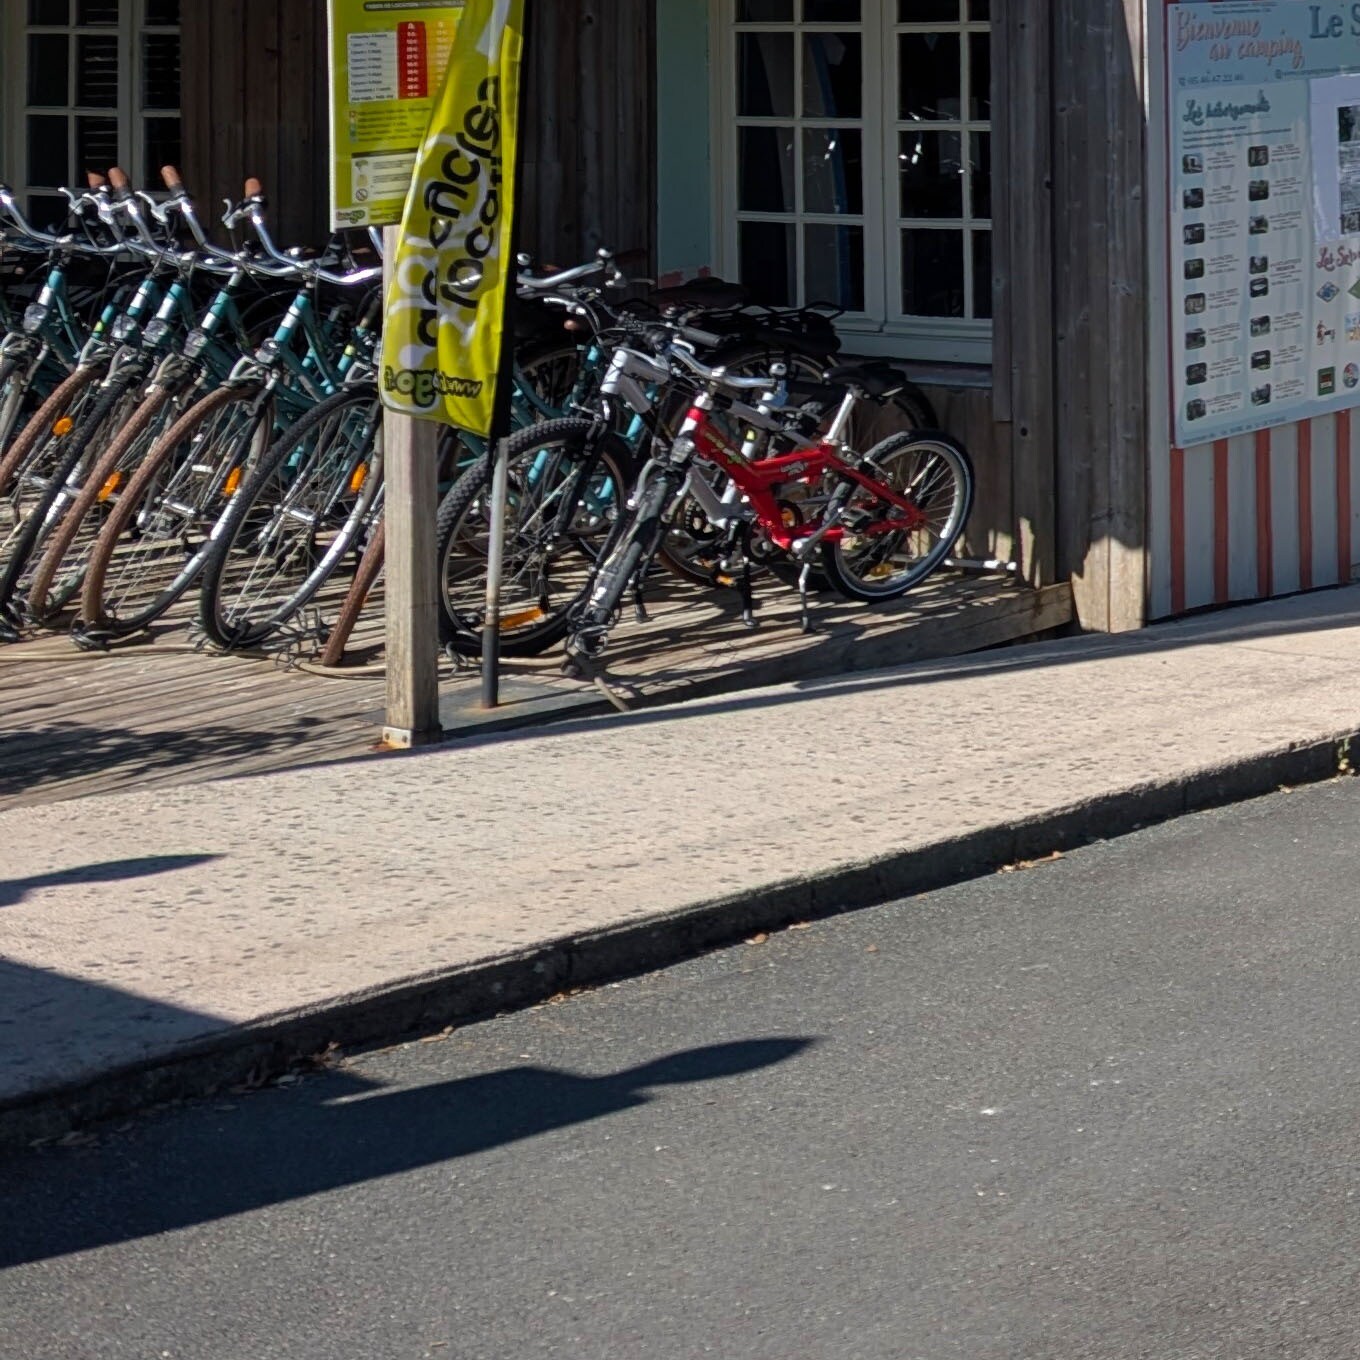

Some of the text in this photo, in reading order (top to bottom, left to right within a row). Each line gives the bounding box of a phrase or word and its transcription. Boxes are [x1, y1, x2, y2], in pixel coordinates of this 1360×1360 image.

[1175, 8, 1262, 52] Bienvenue
[1309, 5, 1343, 39] Le
[1238, 31, 1305, 69] camping
